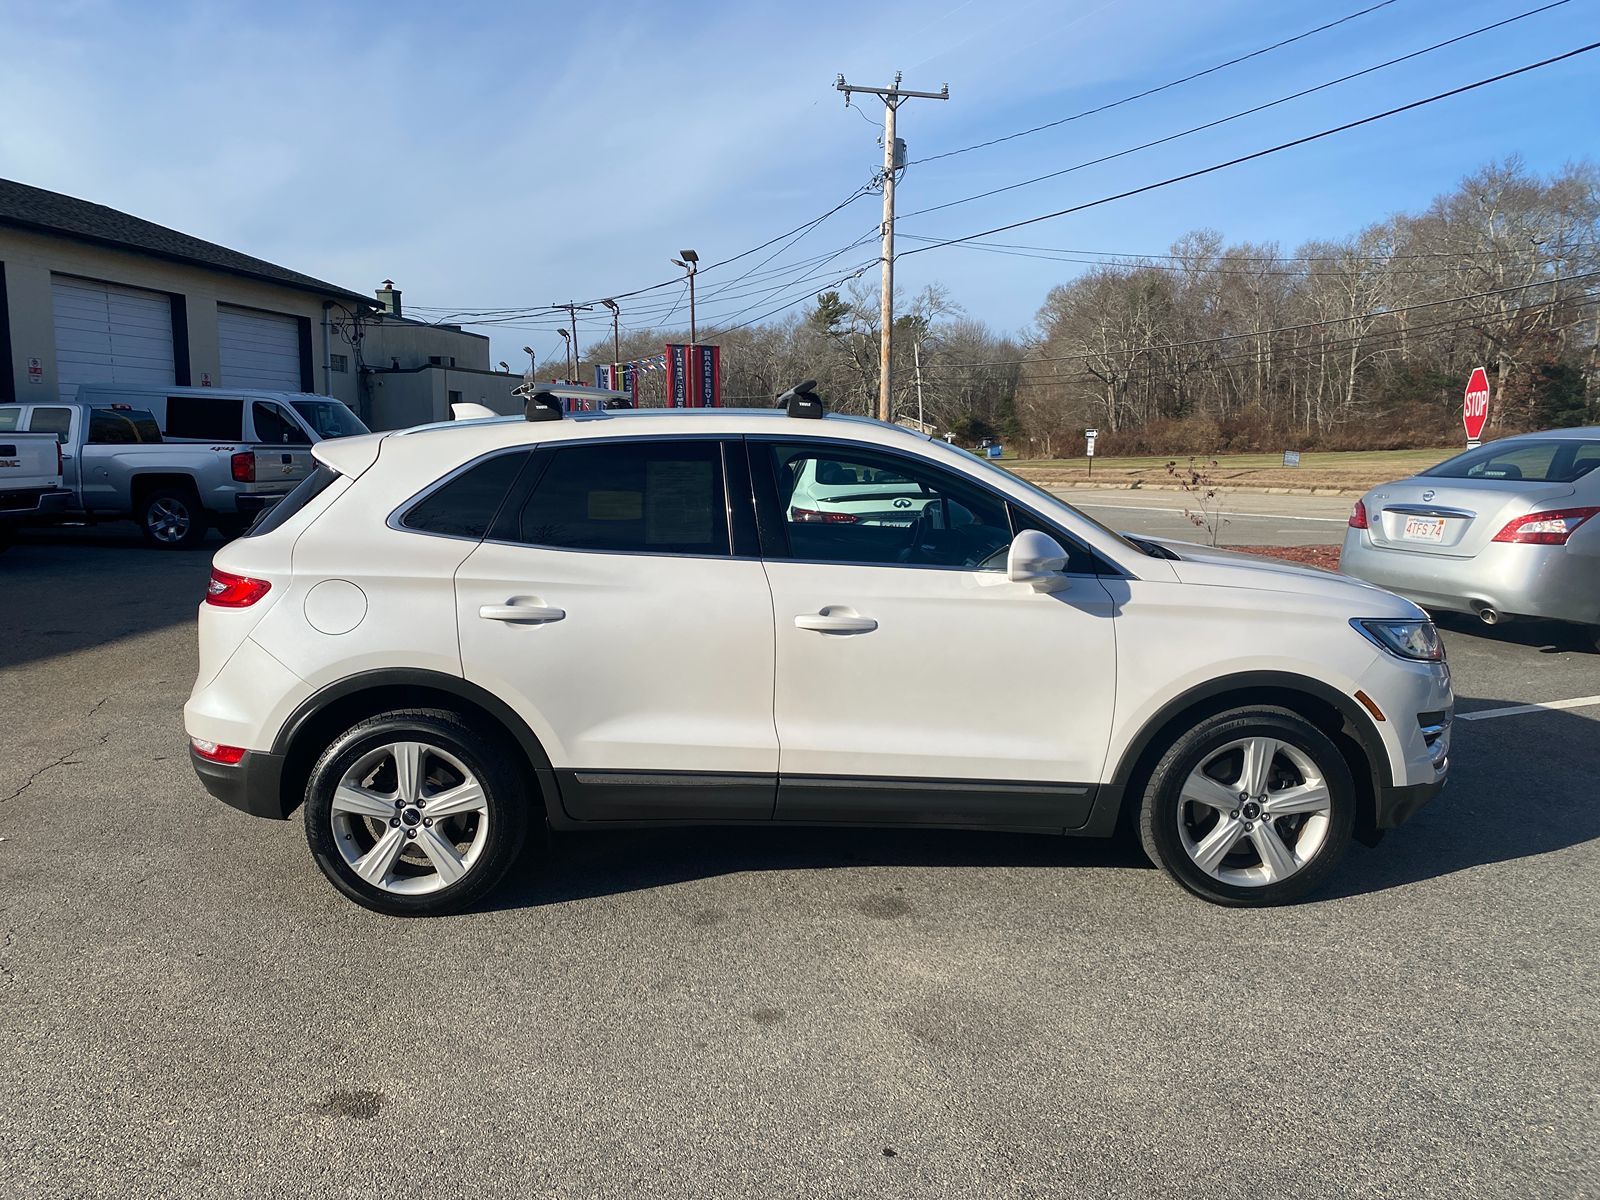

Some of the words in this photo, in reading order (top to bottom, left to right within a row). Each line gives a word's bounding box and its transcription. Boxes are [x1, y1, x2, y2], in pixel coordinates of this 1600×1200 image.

[1465, 391, 1486, 417] STOP
[1406, 522, 1429, 536] 4TFS
[1429, 524, 1442, 537] 74
